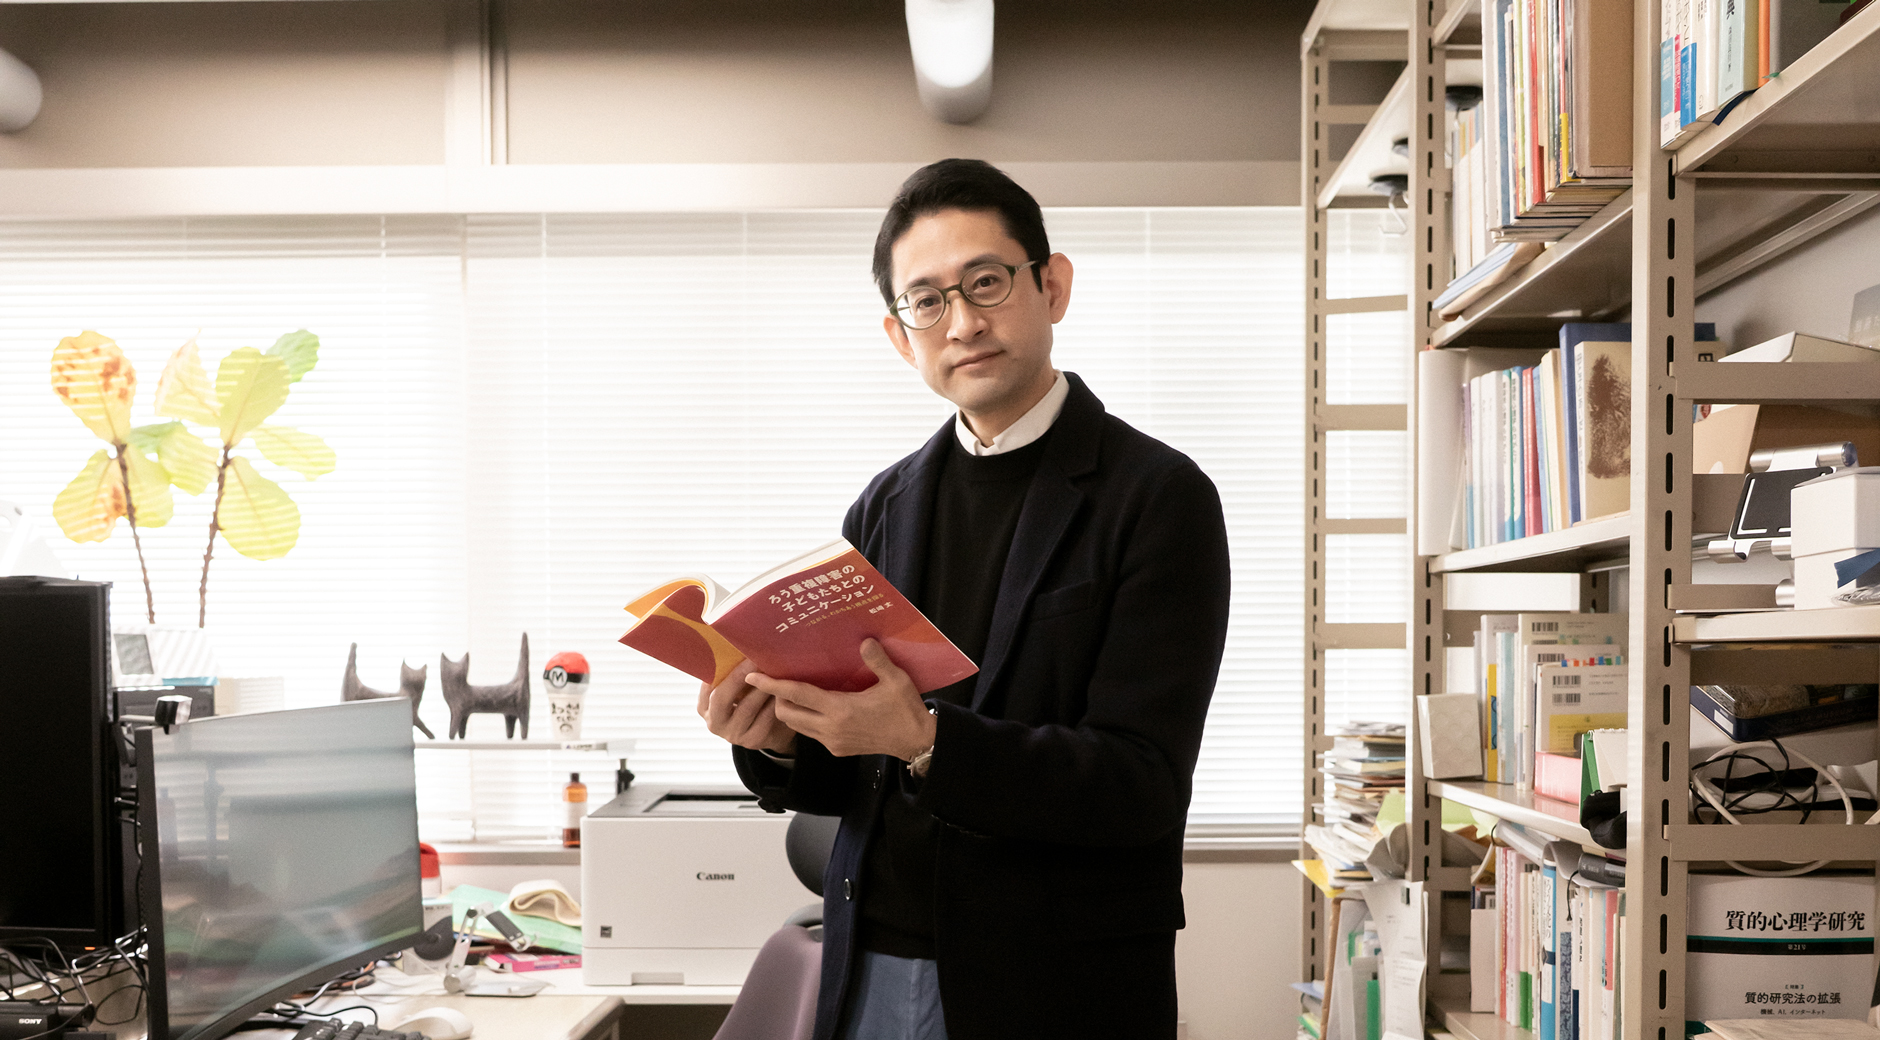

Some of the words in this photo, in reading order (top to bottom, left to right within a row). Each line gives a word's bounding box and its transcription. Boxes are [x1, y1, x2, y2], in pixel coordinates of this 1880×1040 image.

[768, 564, 855, 605] ろう重複障害の
[782, 574, 865, 613] 子どもたちとの
[775, 584, 875, 633] コミュニケーション
[552, 670, 564, 683] M
[696, 871, 735, 881] Canon
[1725, 910, 1865, 932] 質的心理学研究
[1744, 992, 1841, 1004] 質的研究法の拡張
